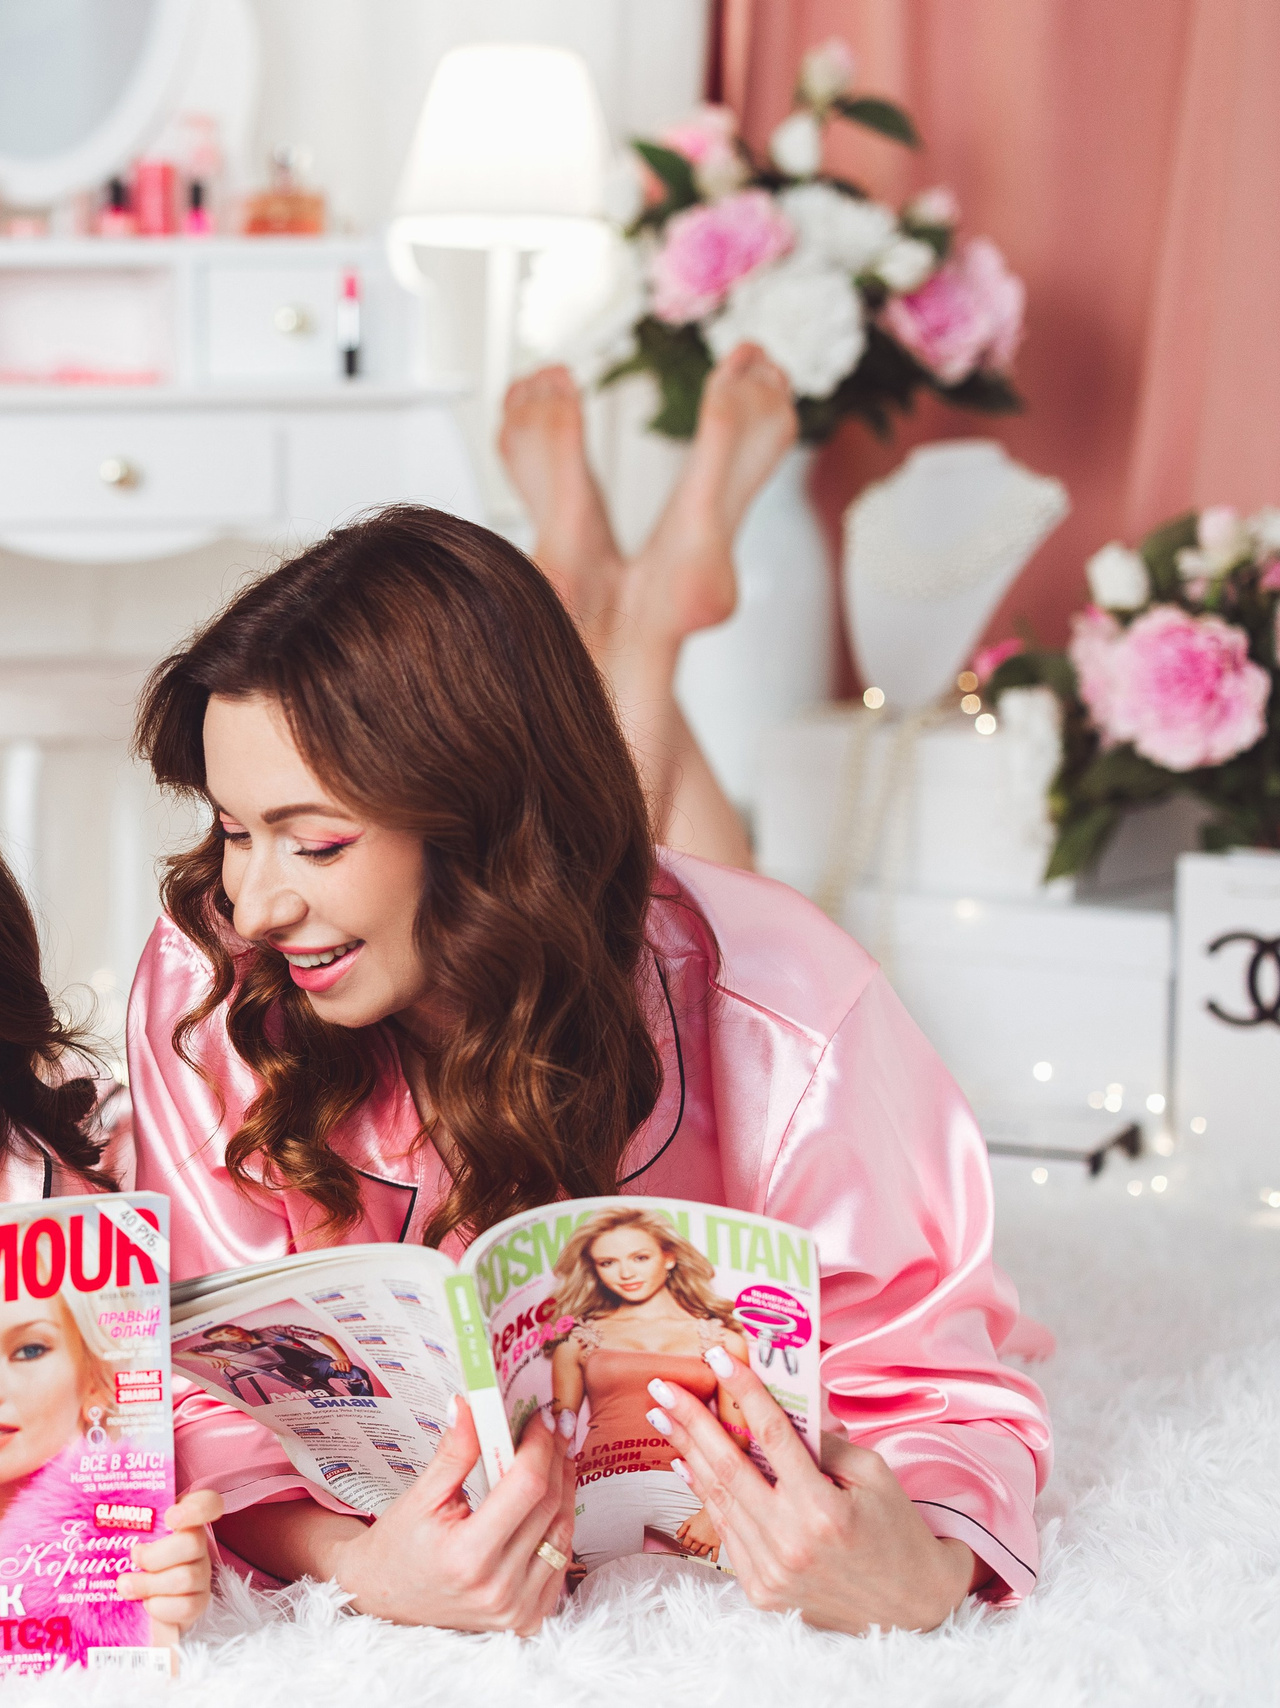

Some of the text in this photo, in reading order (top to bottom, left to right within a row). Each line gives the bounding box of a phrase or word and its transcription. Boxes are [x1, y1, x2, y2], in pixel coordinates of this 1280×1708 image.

[98, 1305, 161, 1325] ПРАВЫЙ
[111, 1323, 161, 1338] ФЛАНГ
[307, 1398, 378, 1408] Билан
[80, 1451, 166, 1472] ВСЕ В ЗАГС!
[82, 1482, 97, 1492] за
[95, 1503, 154, 1522] GLAMOUR
[61, 1520, 139, 1553] Елена
